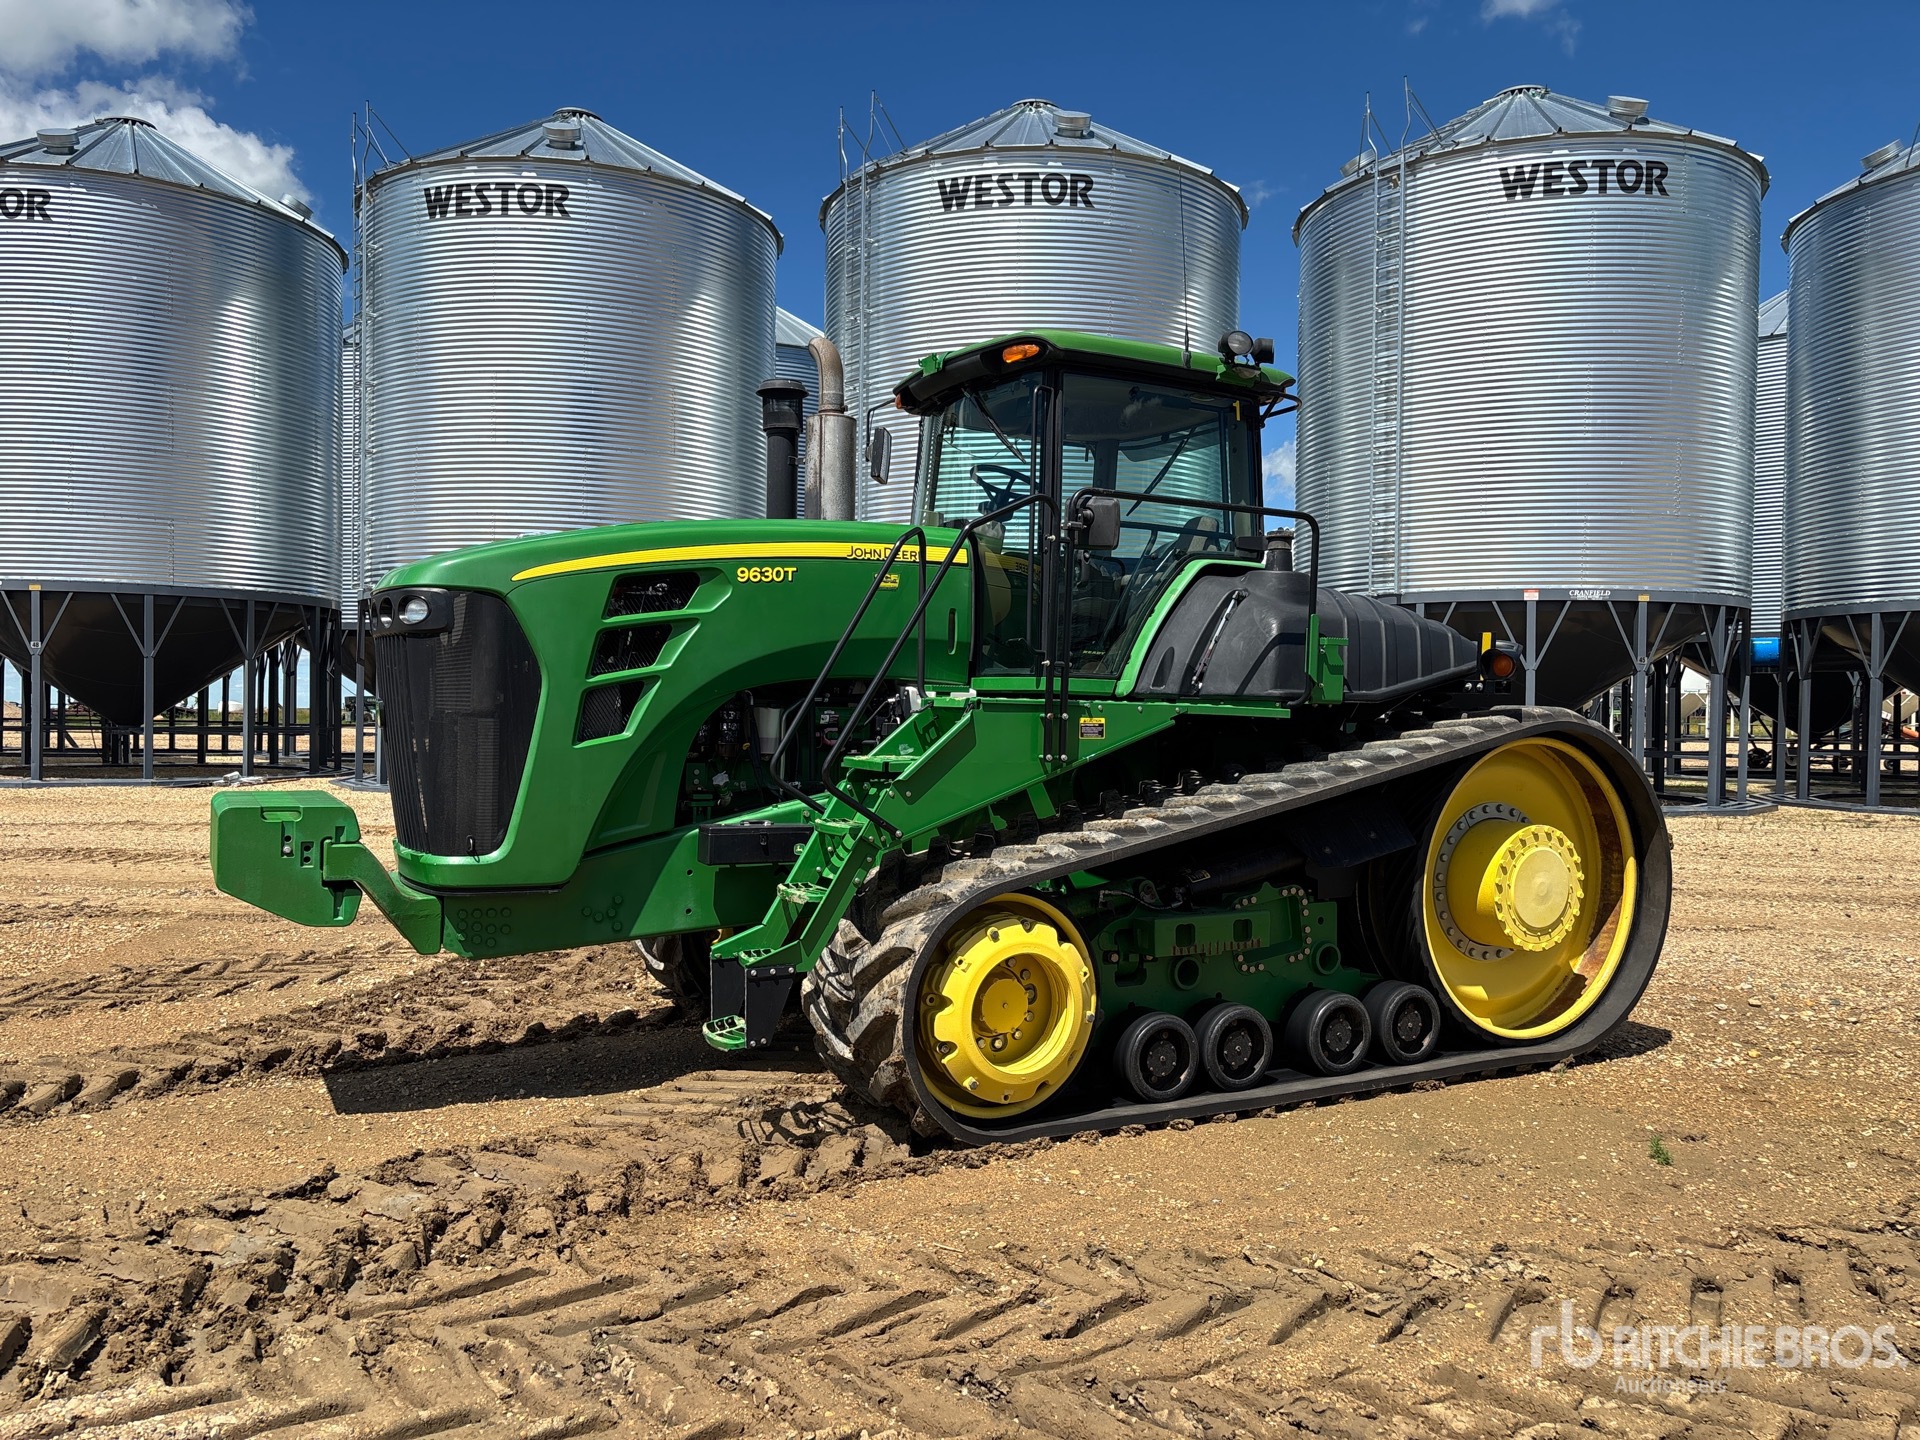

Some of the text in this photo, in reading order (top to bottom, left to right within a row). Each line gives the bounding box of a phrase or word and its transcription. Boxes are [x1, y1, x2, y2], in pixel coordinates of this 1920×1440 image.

[938, 172, 1095, 212] WESTOR
[1499, 159, 1669, 201] WESTOR
[424, 182, 571, 219] WESTOR
[847, 545, 922, 560] JOHN DEER
[736, 566, 799, 583] 9630T
